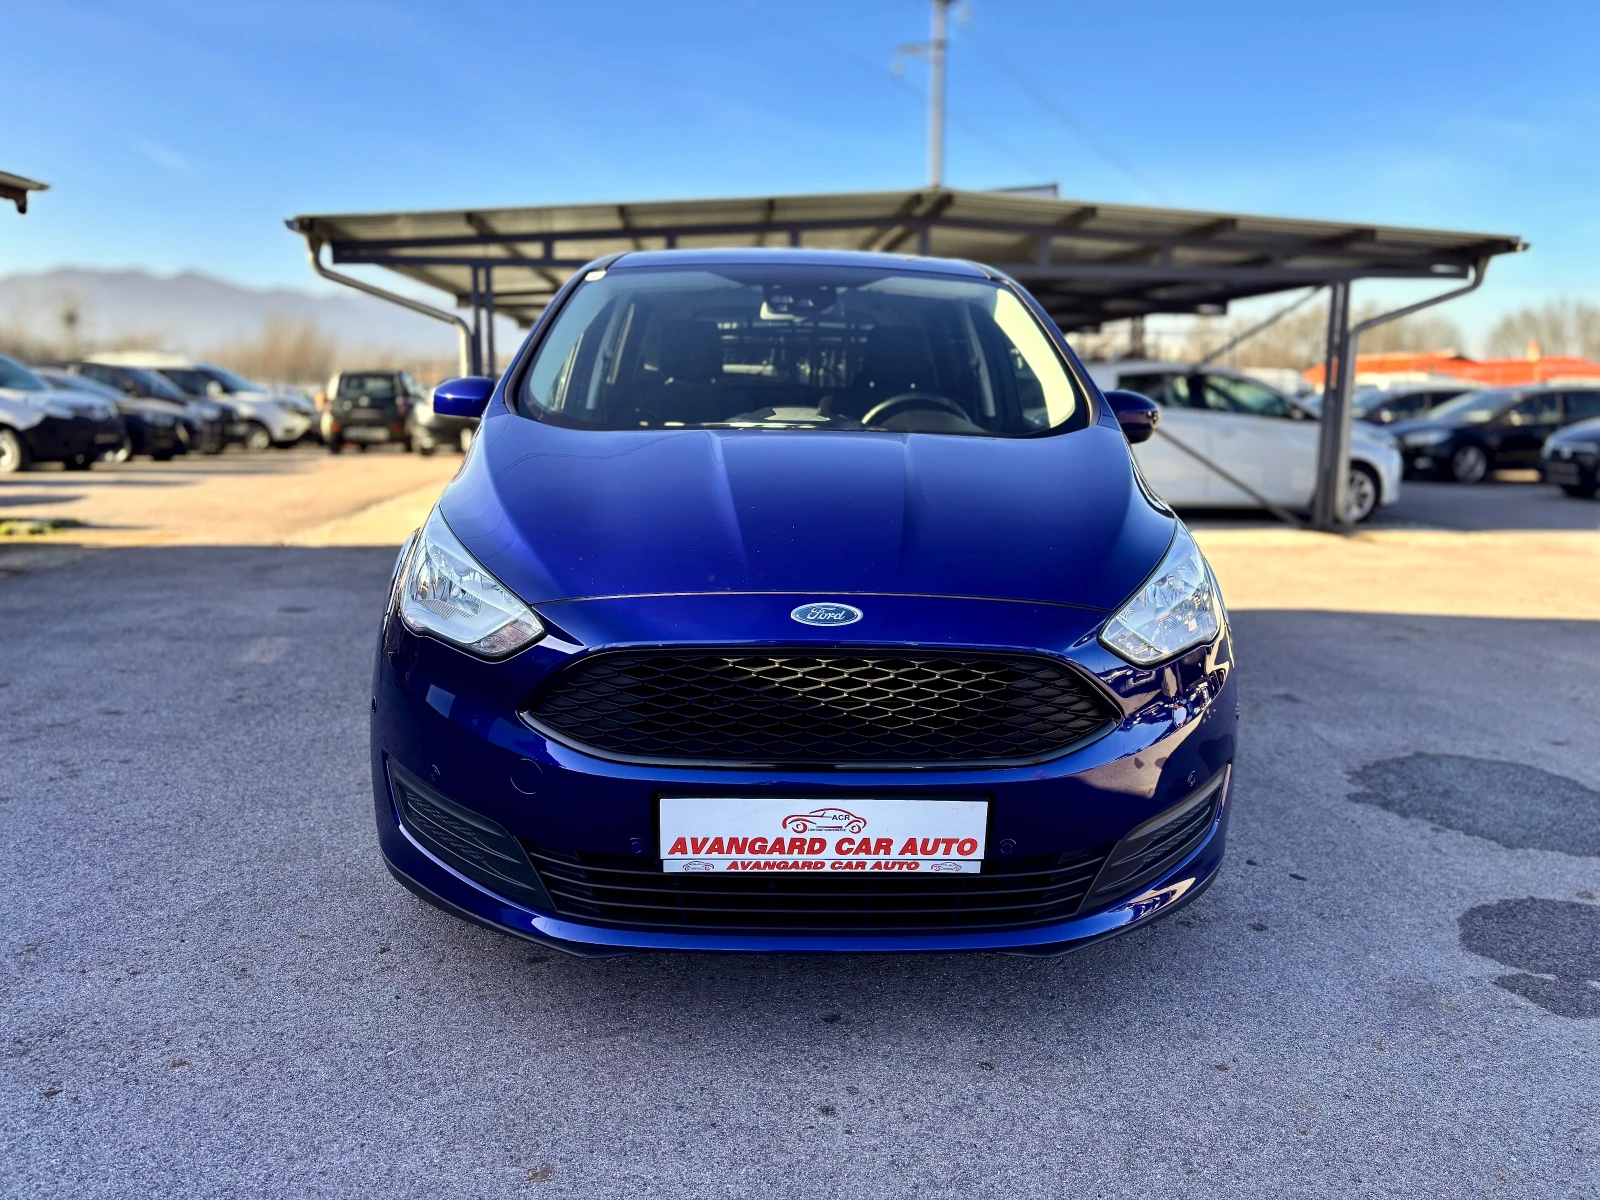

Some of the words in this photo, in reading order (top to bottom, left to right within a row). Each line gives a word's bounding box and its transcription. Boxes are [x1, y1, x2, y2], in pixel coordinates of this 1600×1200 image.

[807, 607, 846, 620] Ford
[668, 837, 827, 855] AVANGARD
[835, 838, 893, 856] CAR
[898, 838, 978, 856] AUTO
[726, 861, 826, 871] AVANGARD
[830, 861, 867, 871] CAR
[870, 861, 920, 871] AUTO
